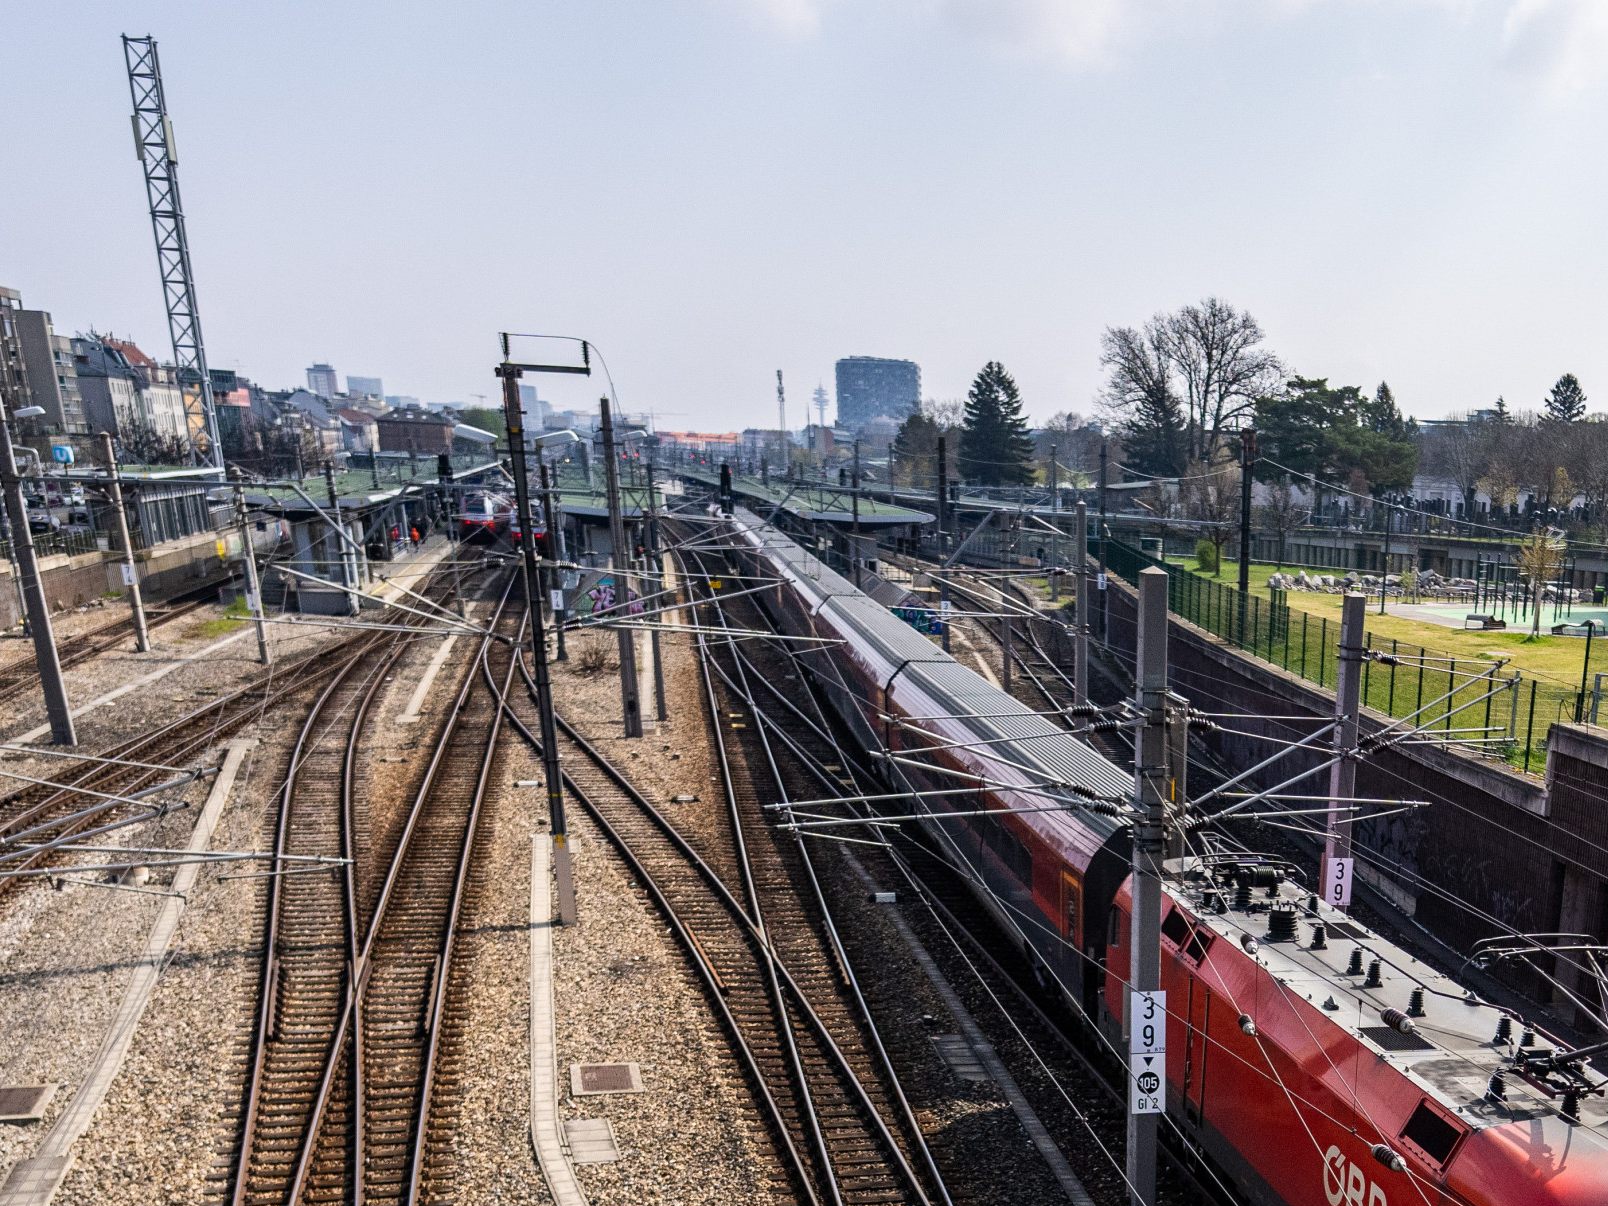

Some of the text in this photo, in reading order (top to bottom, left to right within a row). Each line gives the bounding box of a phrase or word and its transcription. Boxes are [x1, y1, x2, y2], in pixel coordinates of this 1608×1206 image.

[1335, 862, 1345, 881] 3
[1334, 883, 1344, 901] 9
[1143, 997, 1155, 1020] 3
[1143, 1024, 1155, 1047] 9
[1139, 1076, 1158, 1090] 105
[1152, 1097, 1159, 1109] 2
